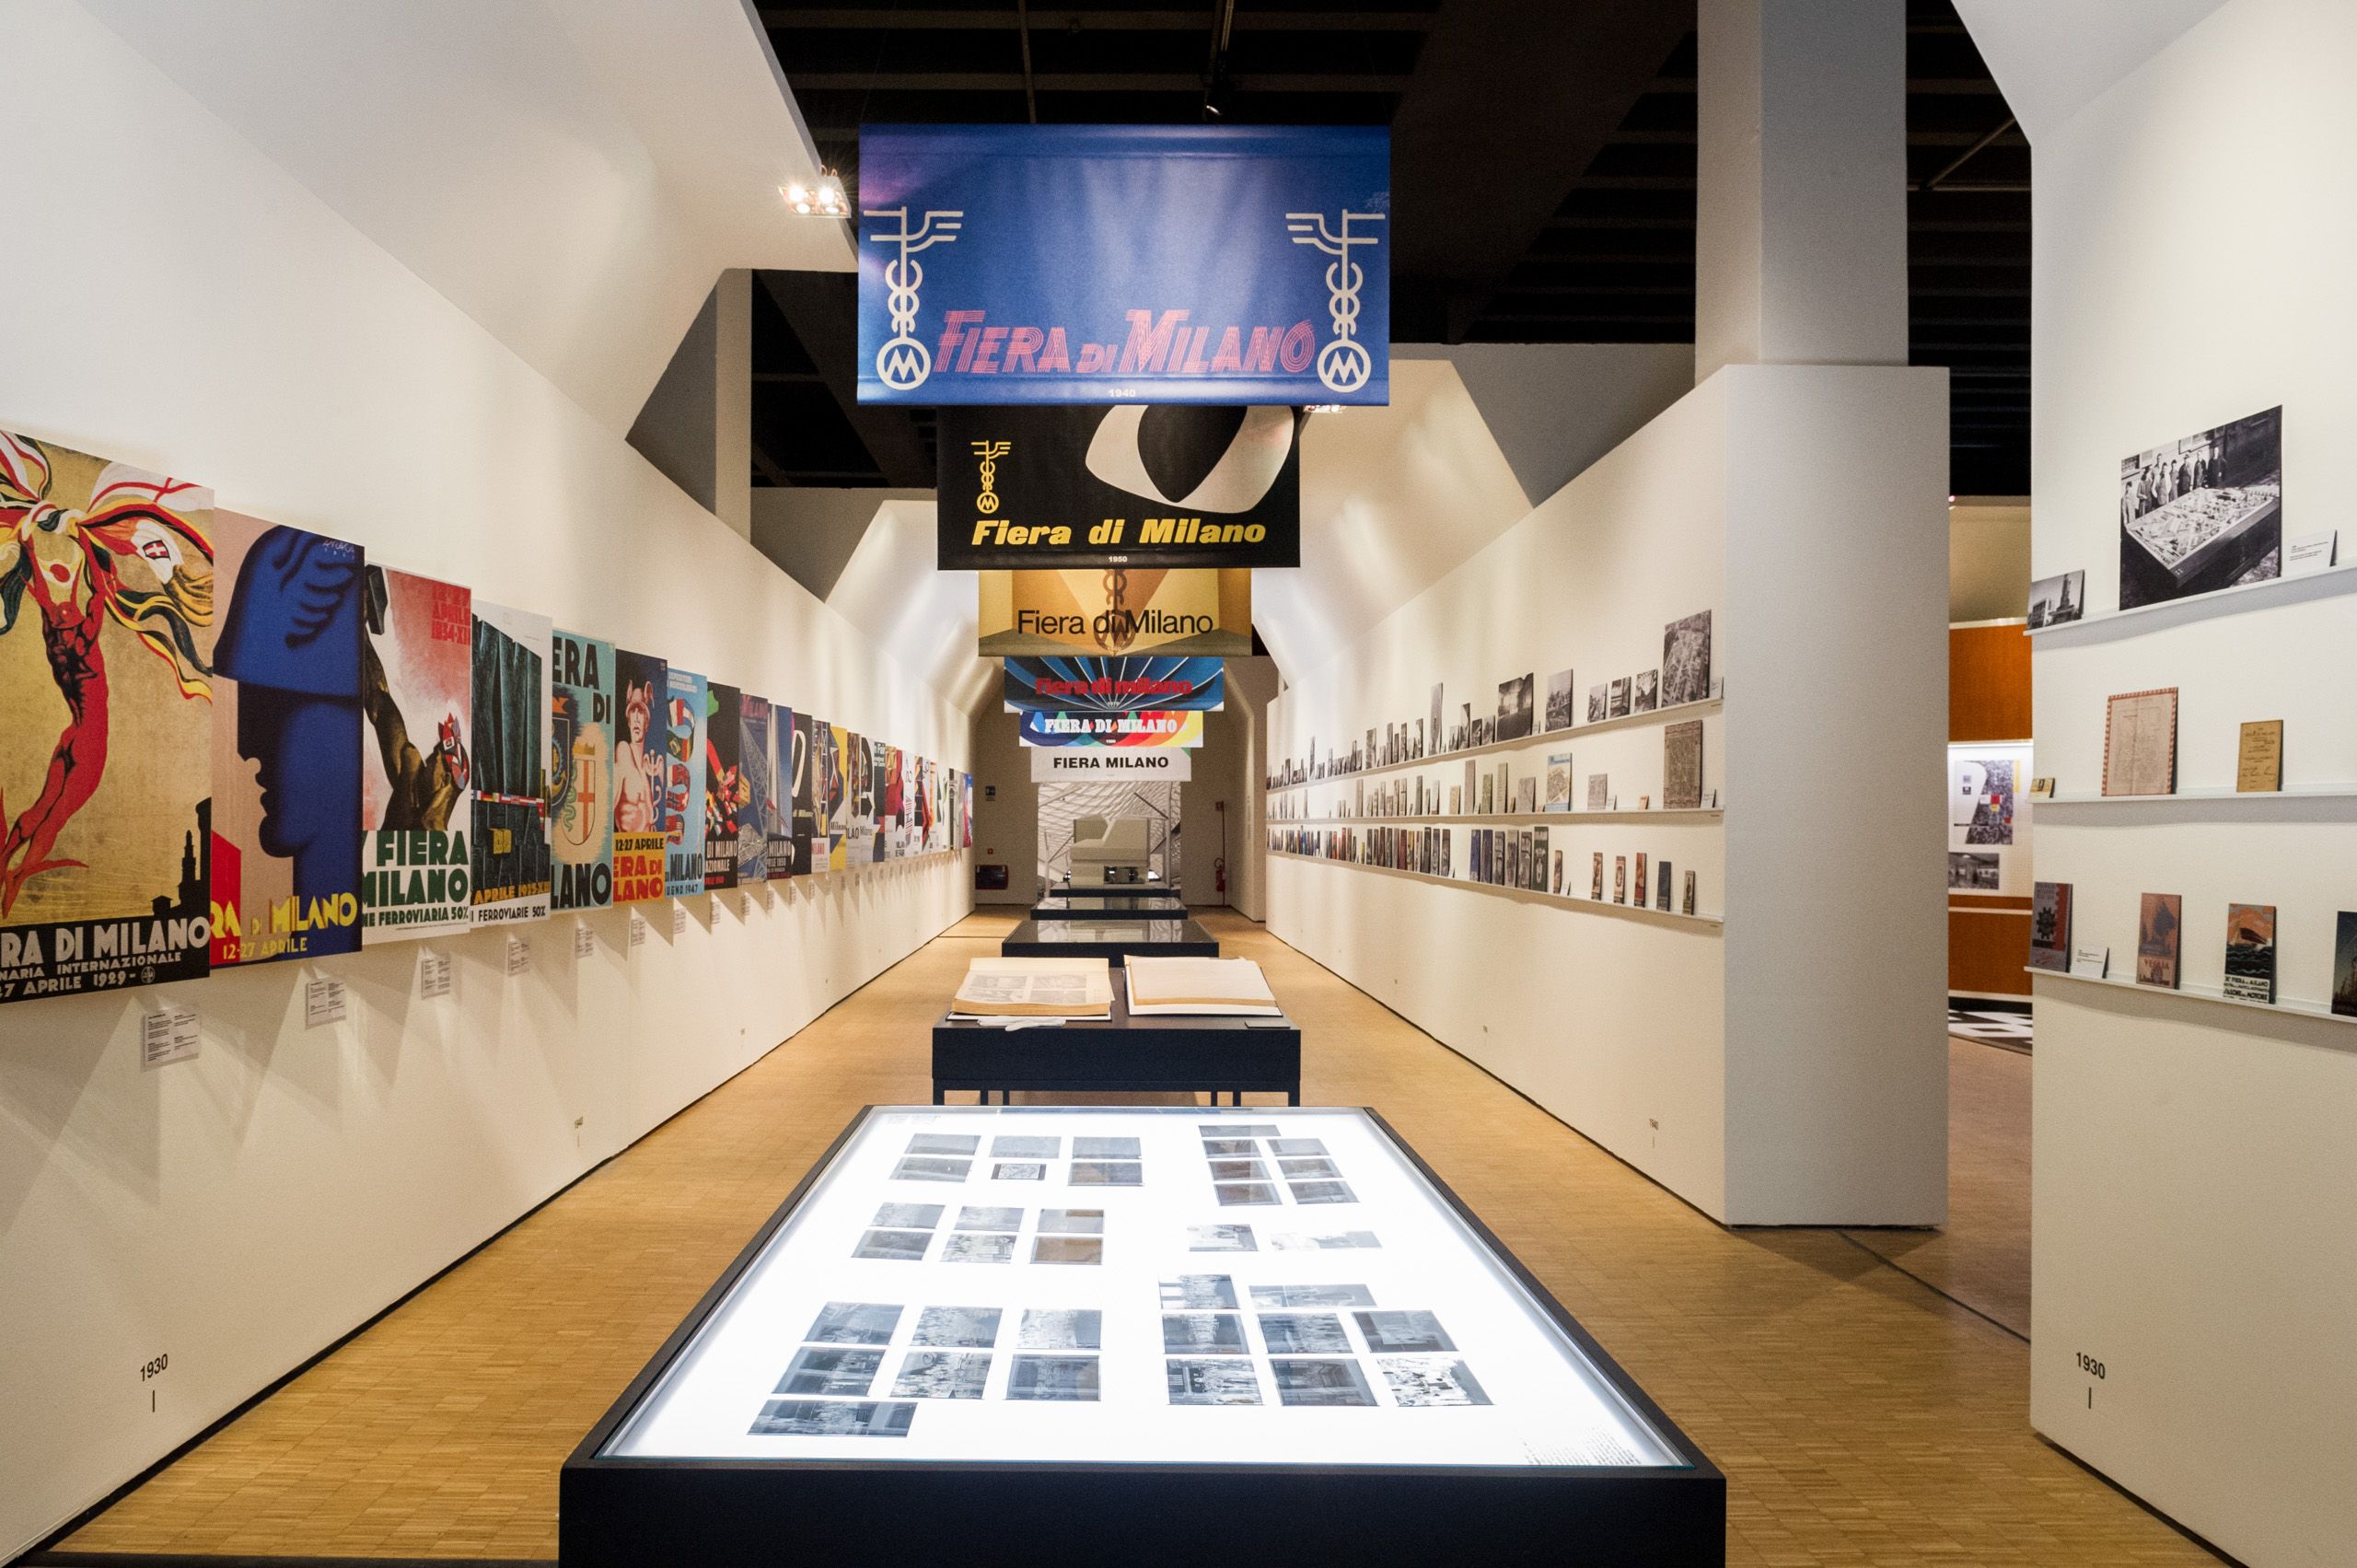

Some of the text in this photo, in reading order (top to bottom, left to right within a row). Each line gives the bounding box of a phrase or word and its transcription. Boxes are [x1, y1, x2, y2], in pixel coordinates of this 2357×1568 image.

[935, 309, 1315, 374] FIERA DI MILANO
[1109, 389, 1136, 398] 1940
[971, 518, 1266, 545] Fiera di Milano
[1018, 610, 1213, 634] Fiera di Milano
[552, 636, 599, 690] ERA
[1035, 677, 1192, 694] fiera di milano
[593, 692, 611, 724] DI
[1045, 719, 1177, 733] FIERA DI MILANO
[1053, 757, 1168, 769] FIERA MILANO
[377, 830, 470, 866] FIERA
[634, 838, 665, 851] APRILE
[706, 840, 737, 859] DI MILANO
[649, 859, 662, 876] DI
[670, 854, 703, 882] MILANO
[363, 868, 469, 908] MILANO
[474, 885, 516, 905] APRILE
[552, 863, 611, 910] LANO
[270, 892, 357, 934] MILANO
[379, 906, 449, 926] FERROVIARIA
[450, 905, 470, 921] 50%
[478, 906, 528, 923] FERROVIARIE
[532, 906, 546, 917] 50%
[1, 916, 211, 967] RA DI MILANO
[261, 937, 308, 956] APRILE
[57, 952, 181, 975] INTERNAZIONALE
[23, 976, 82, 995] APRILE
[140, 1353, 168, 1382] 1930
[2076, 1352, 2106, 1380] 1930
